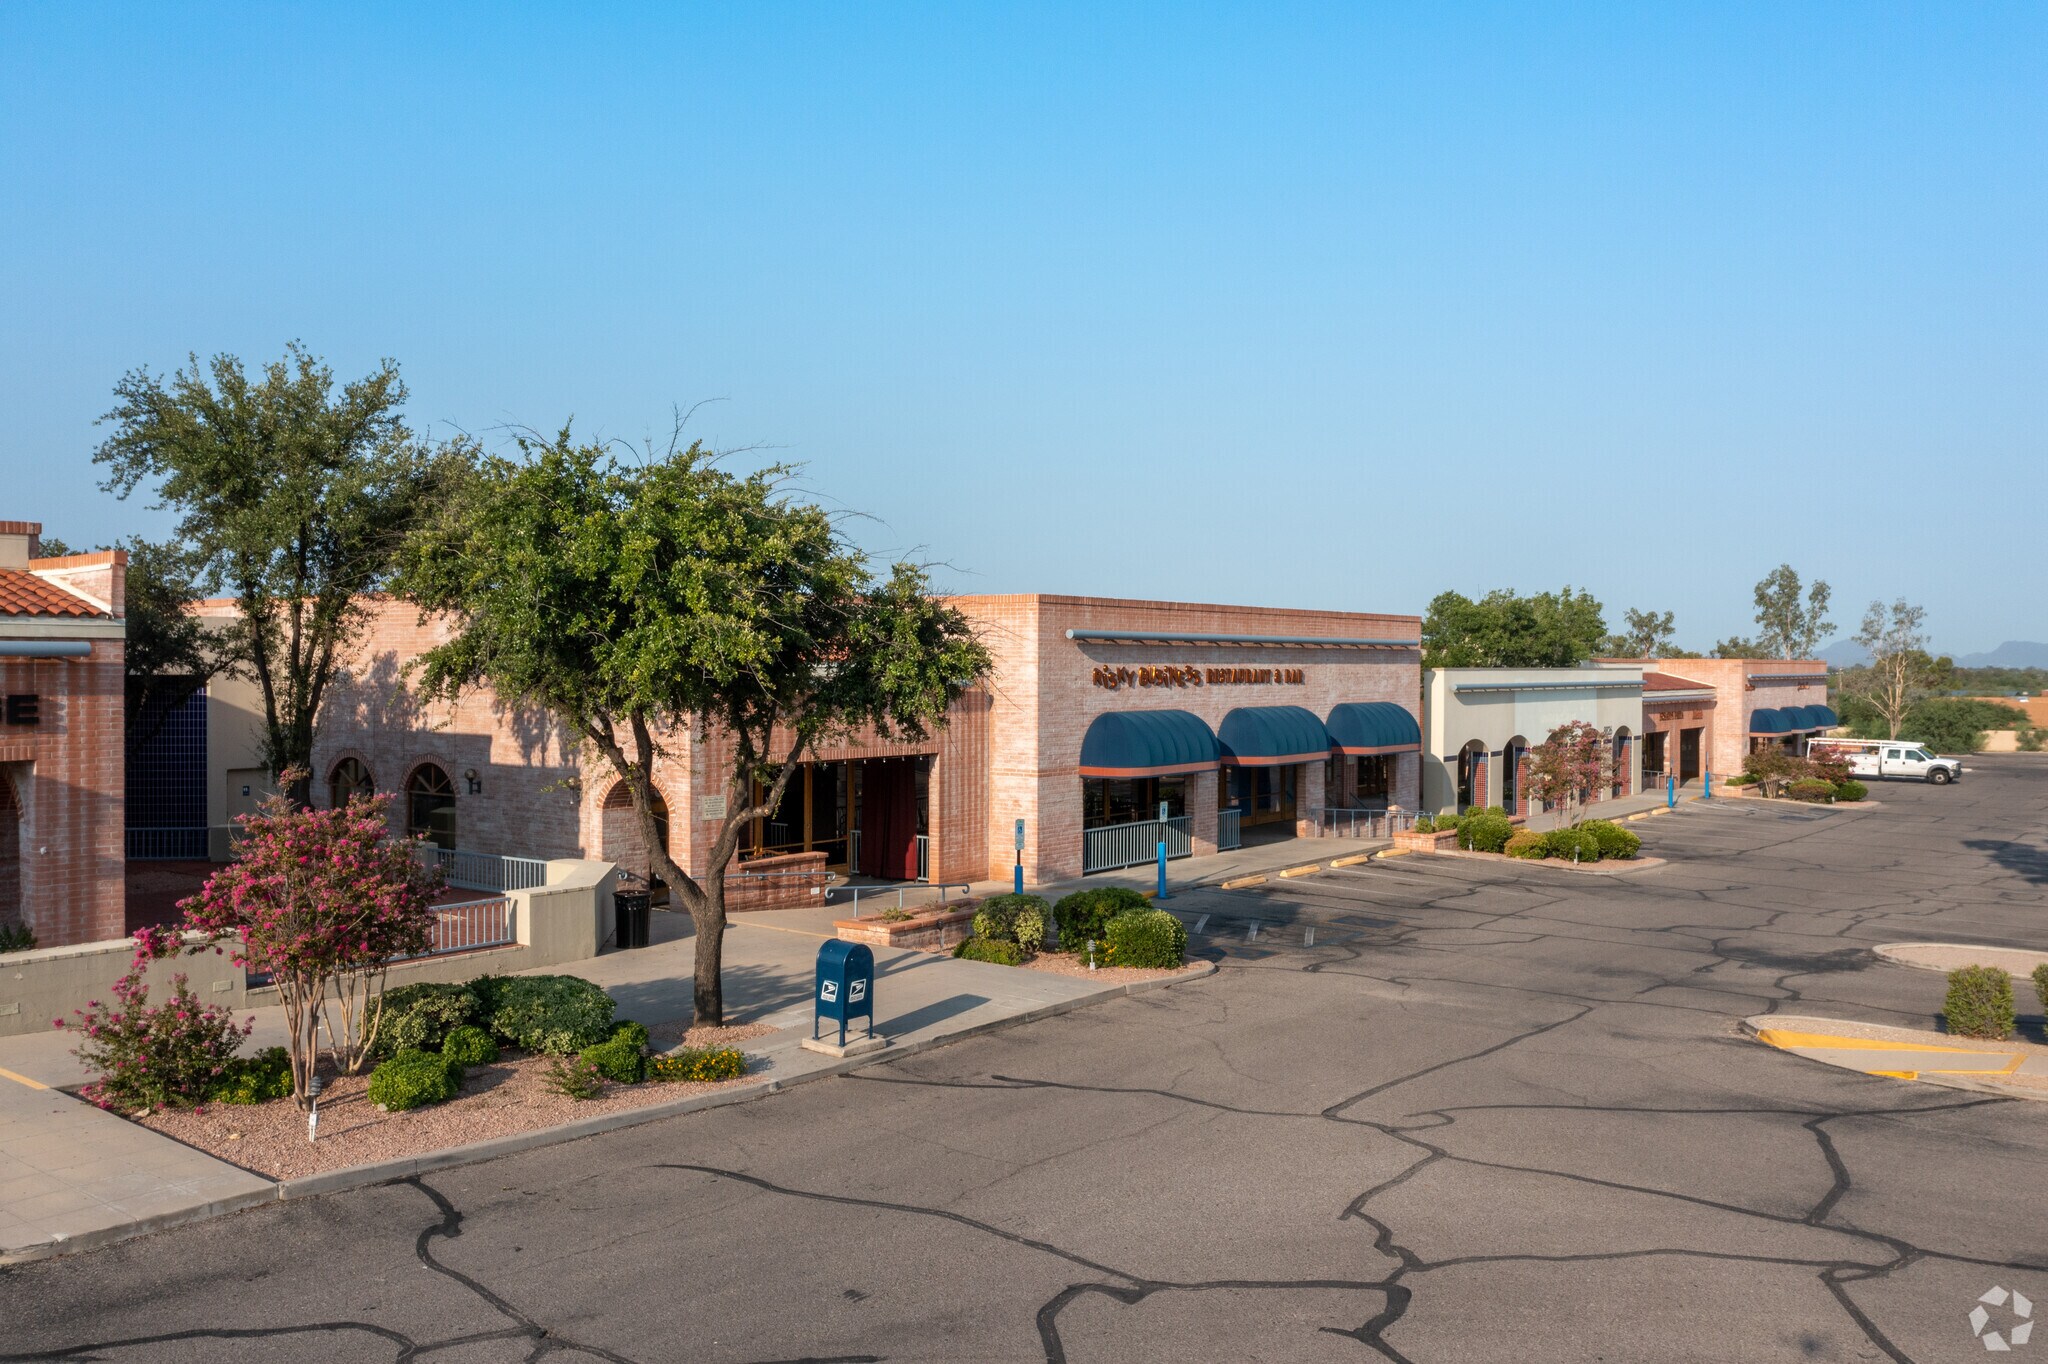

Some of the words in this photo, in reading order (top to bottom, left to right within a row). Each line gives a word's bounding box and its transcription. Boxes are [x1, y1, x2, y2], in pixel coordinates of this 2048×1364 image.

[1206, 668, 1271, 684] RESTAURANT
[1284, 668, 1303, 684] BAR
[0, 694, 39, 725] E
